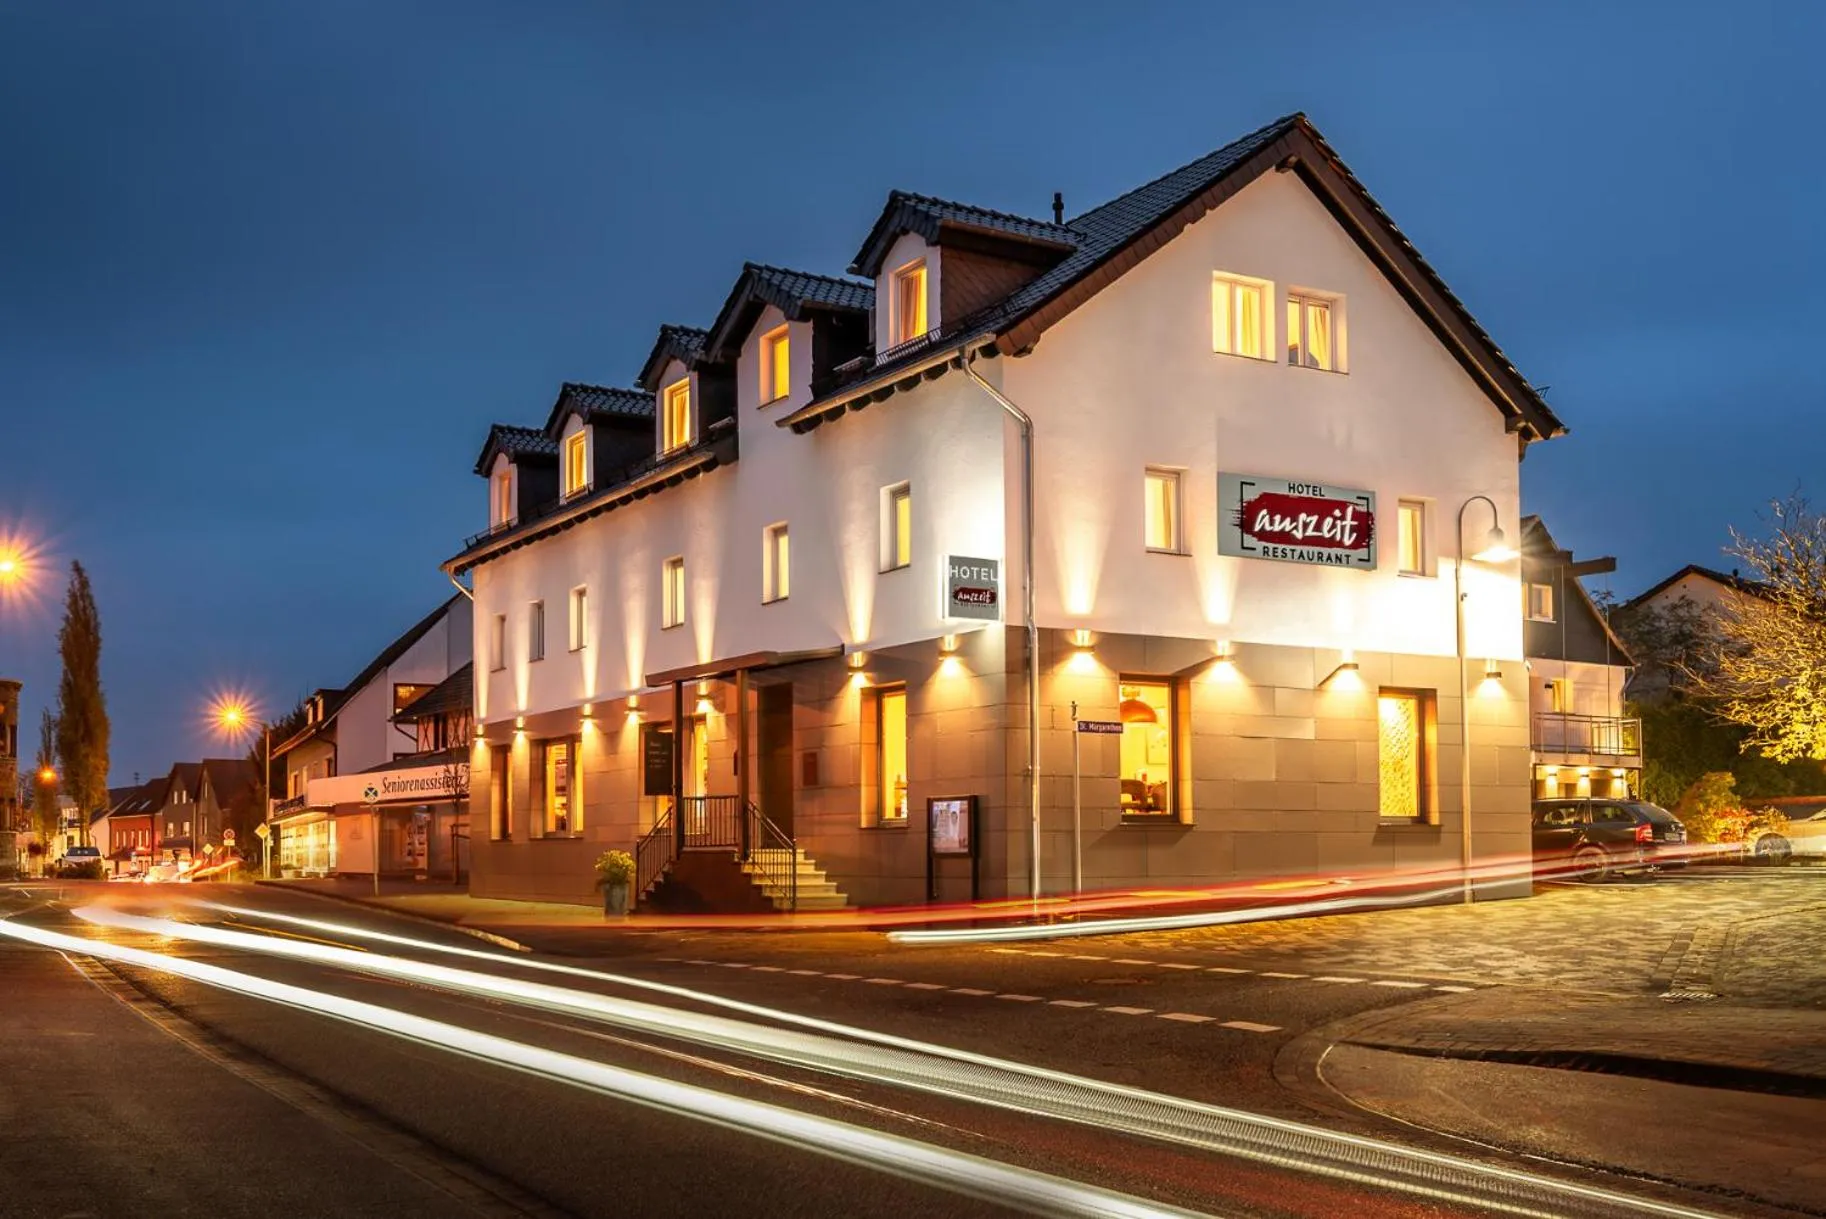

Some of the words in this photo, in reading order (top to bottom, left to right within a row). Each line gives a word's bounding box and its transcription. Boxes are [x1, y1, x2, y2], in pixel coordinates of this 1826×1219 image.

[1287, 482, 1325, 497] HOTEL
[1254, 505, 1358, 546] auszeit
[1262, 546, 1352, 565] RESTAURANT
[949, 564, 998, 581] HOTEL
